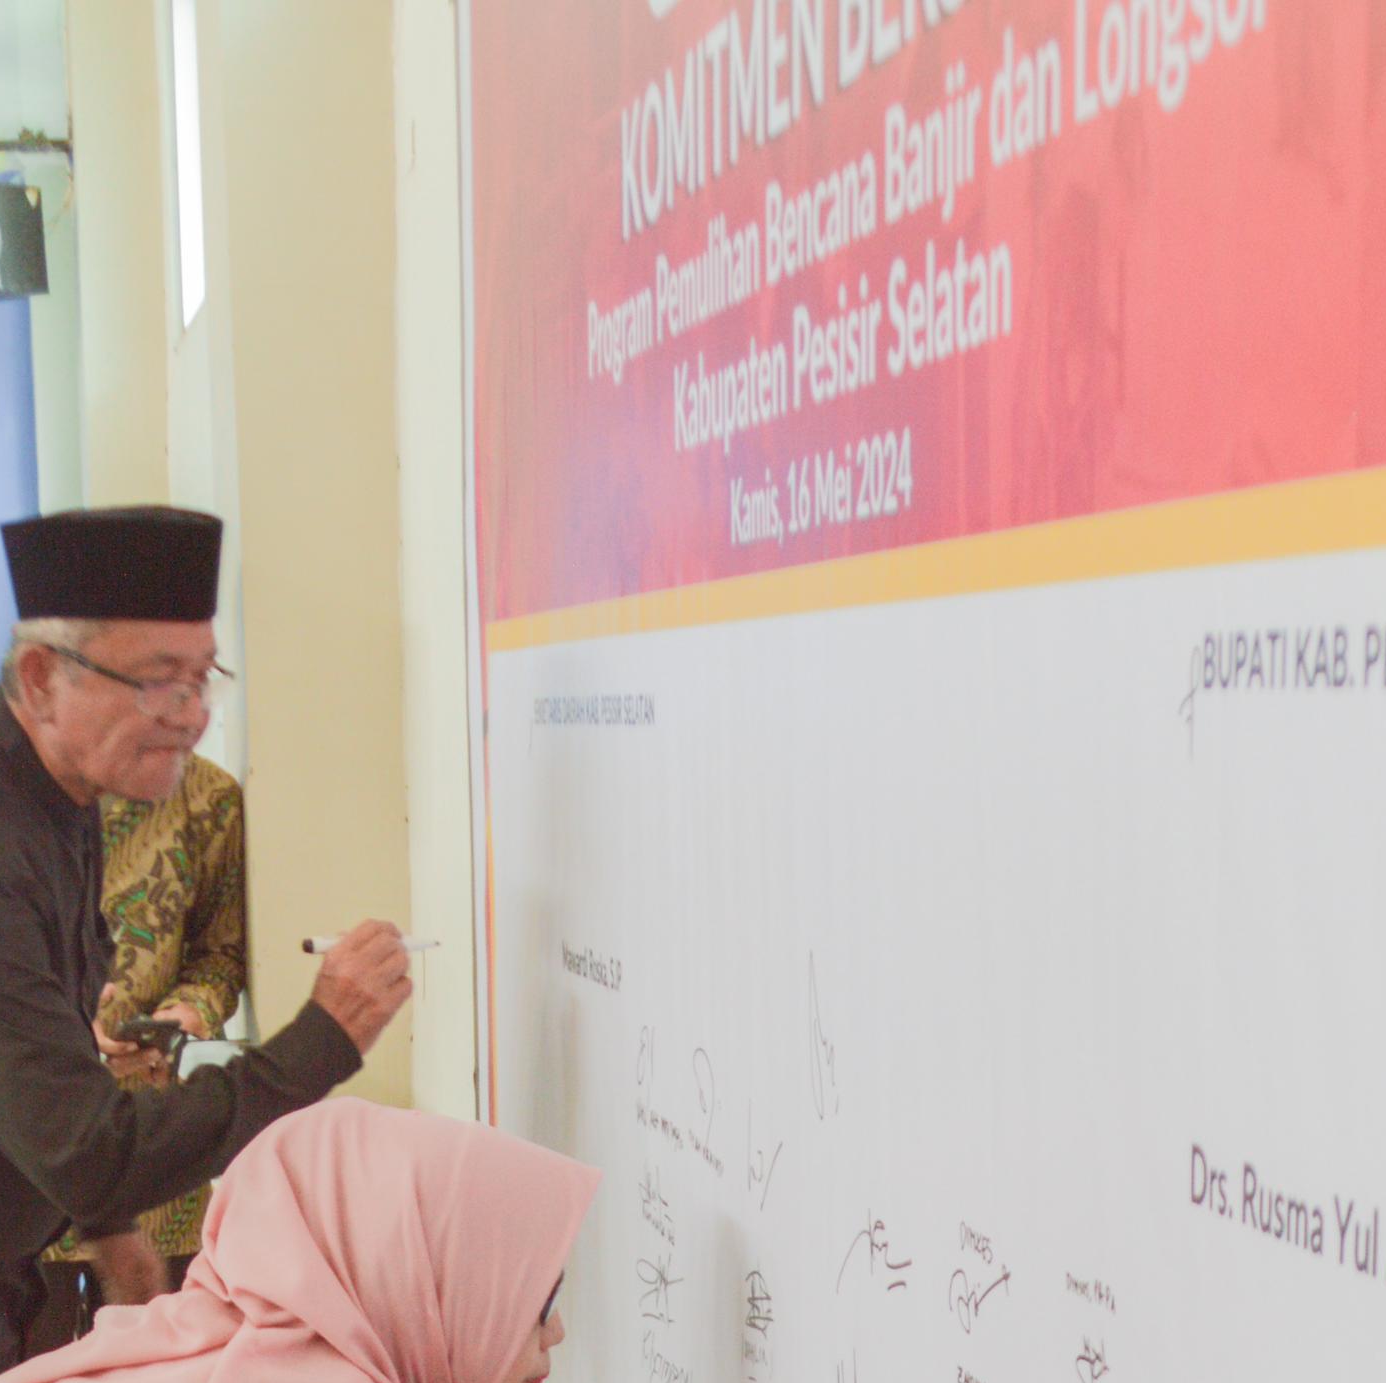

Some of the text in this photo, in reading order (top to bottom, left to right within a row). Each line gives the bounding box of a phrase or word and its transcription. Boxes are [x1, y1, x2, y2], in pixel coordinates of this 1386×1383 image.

[587, 286, 653, 386] Program
[655, 211, 760, 345] Pemulihan
[765, 150, 876, 288] Bencana
[885, 60, 981, 224] Banjir
[989, 25, 1060, 168] dan
[621, 0, 825, 243] KOMITMEN
[674, 238, 1011, 456] Kabupaten Pesisir Selatan
[730, 424, 913, 546] Kamis, 16 Mei 2024
[1202, 630, 1288, 690] BUPATI
[1295, 626, 1354, 689] KAB.
[1190, 1143, 1234, 1219] Drs.
[1242, 1162, 1324, 1257] Rusma
[1335, 1193, 1380, 1278] Yul
